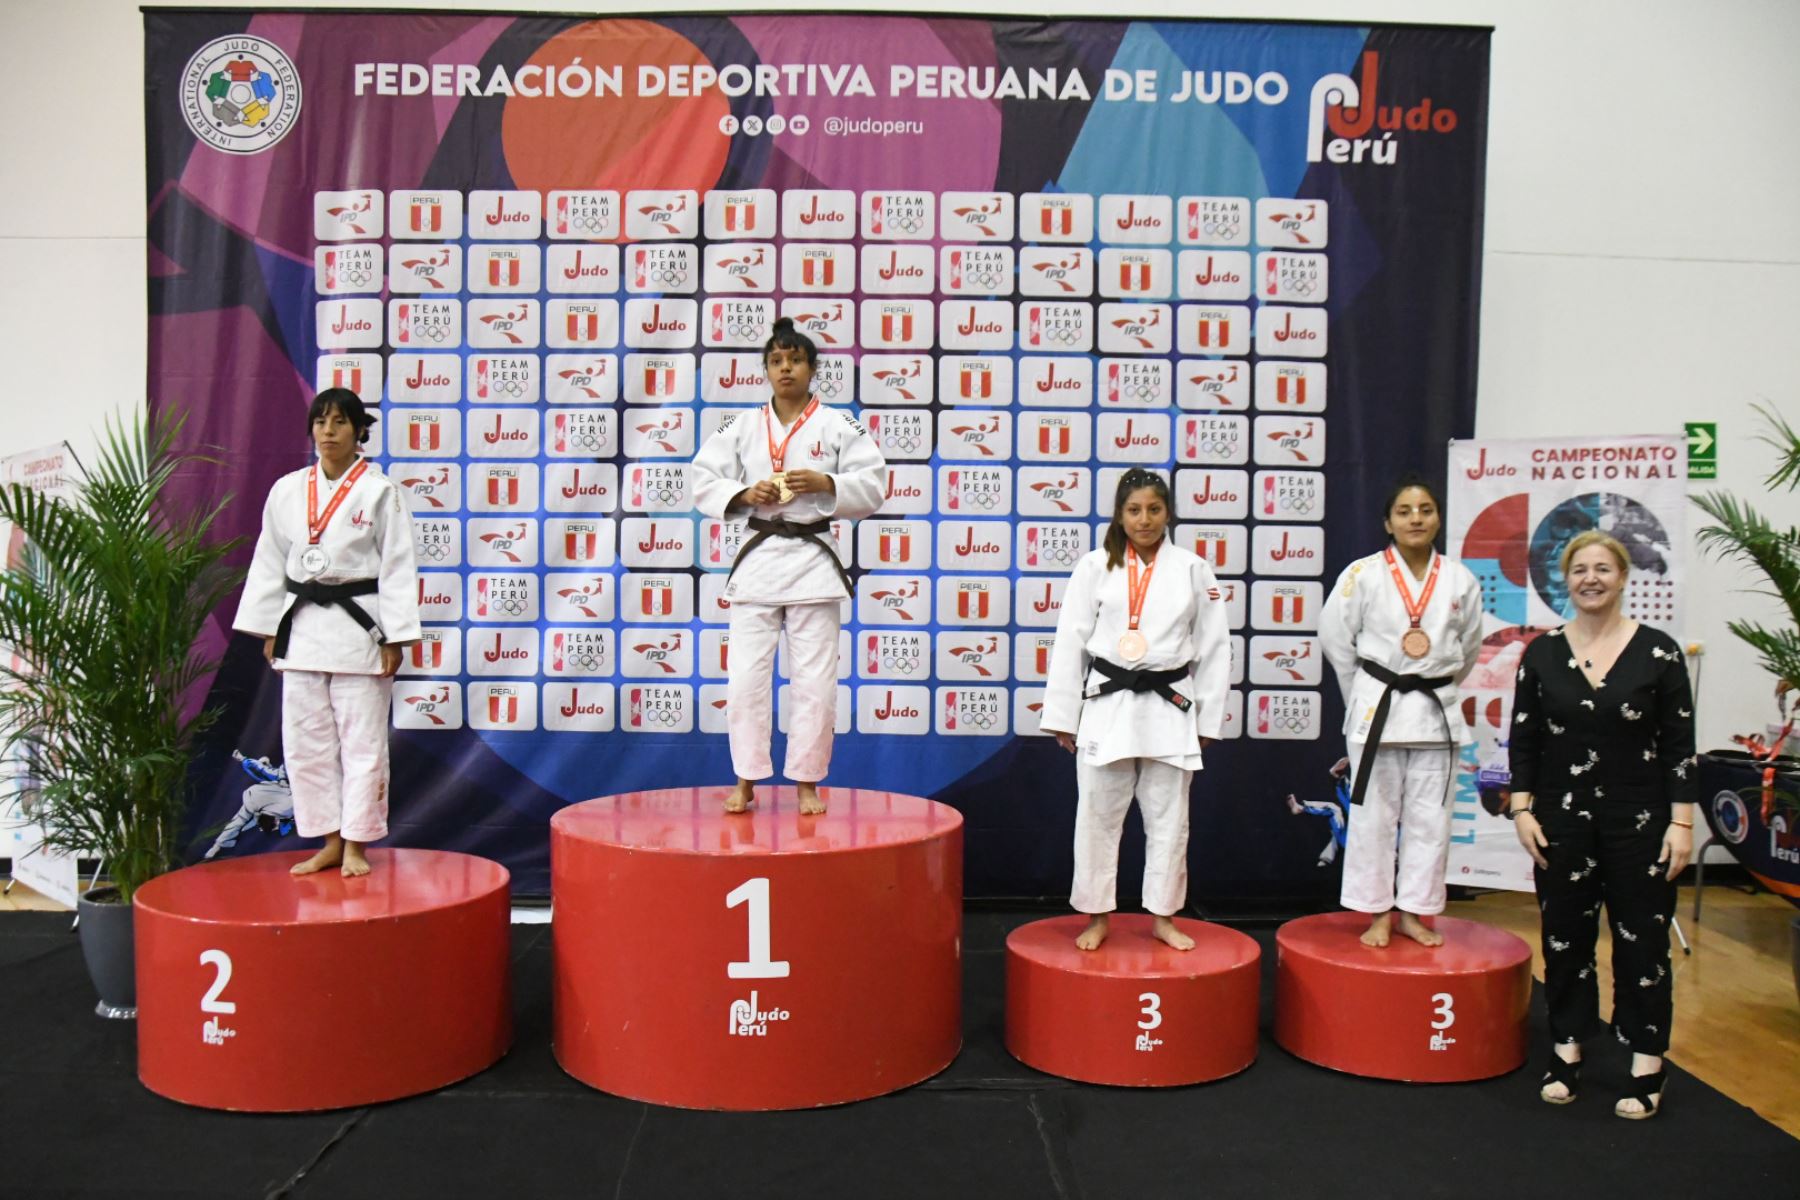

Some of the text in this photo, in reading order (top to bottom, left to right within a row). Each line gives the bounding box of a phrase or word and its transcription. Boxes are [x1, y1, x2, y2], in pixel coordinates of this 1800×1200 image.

[186, 40, 295, 146] INTERNATIONAL JUDO FEDERATION
[354, 57, 1290, 105] FEDERACIÓN DEPORTIVA PERUANA DE JUDO
[824, 116, 924, 137] @judoperu
[486, 196, 530, 226] Judo
[572, 196, 608, 206] TEAM
[800, 195, 844, 225] Judo
[887, 196, 923, 206] TEAM
[1117, 200, 1161, 230] Judo
[1203, 202, 1239, 212] TEAM
[337, 249, 371, 259] TEAM
[564, 250, 608, 280] Judo
[650, 249, 686, 259] TEAM
[879, 250, 923, 280] Judo
[966, 251, 1002, 261] TEAM
[1281, 258, 1316, 268] TEAM
[1195, 256, 1239, 286] Judo
[330, 304, 371, 334] Judo
[414, 304, 450, 314] TEAM
[642, 304, 686, 334] Judo
[728, 303, 764, 313] TEAM
[958, 306, 1002, 336] Judo
[1045, 307, 1081, 317] TEAM
[1274, 313, 1316, 343] Judo
[406, 359, 450, 389] Judo
[492, 359, 528, 369] TEAM
[720, 359, 762, 389] Judo
[1037, 363, 1081, 393] Judo
[1124, 364, 1160, 374] TEAM
[484, 414, 528, 444] Judo
[570, 413, 606, 423] TEAM
[885, 415, 921, 425] TEAM
[1201, 420, 1237, 430] TEAM
[1115, 419, 1159, 449] Judo
[1466, 448, 1517, 481] Judo
[1531, 446, 1677, 463] CAMPEONATO
[562, 469, 606, 499] Judo
[647, 468, 683, 478] TEAM
[964, 471, 1000, 481] TEAM
[1279, 476, 1314, 486] TEAM
[1531, 465, 1677, 480] NACIONAL
[1193, 475, 1237, 505] Judo
[638, 523, 682, 553] Judo
[955, 527, 999, 557] Judo
[1043, 527, 1079, 537] TEAM
[1272, 531, 1314, 561] Judo
[491, 578, 526, 588] TEAM
[484, 632, 528, 662] Judo
[568, 633, 603, 643] TEAM
[883, 636, 919, 646] TEAM
[561, 688, 603, 718] Judo
[646, 689, 682, 699] TEAM
[876, 691, 918, 721] Judo
[961, 692, 997, 702] TEAM
[1274, 696, 1310, 706] TEAM
[1450, 741, 1480, 845] LIMA
[726, 877, 790, 979] 1
[199, 949, 236, 1015] 2
[1137, 992, 1163, 1030] 3
[1431, 992, 1456, 1030] 3
